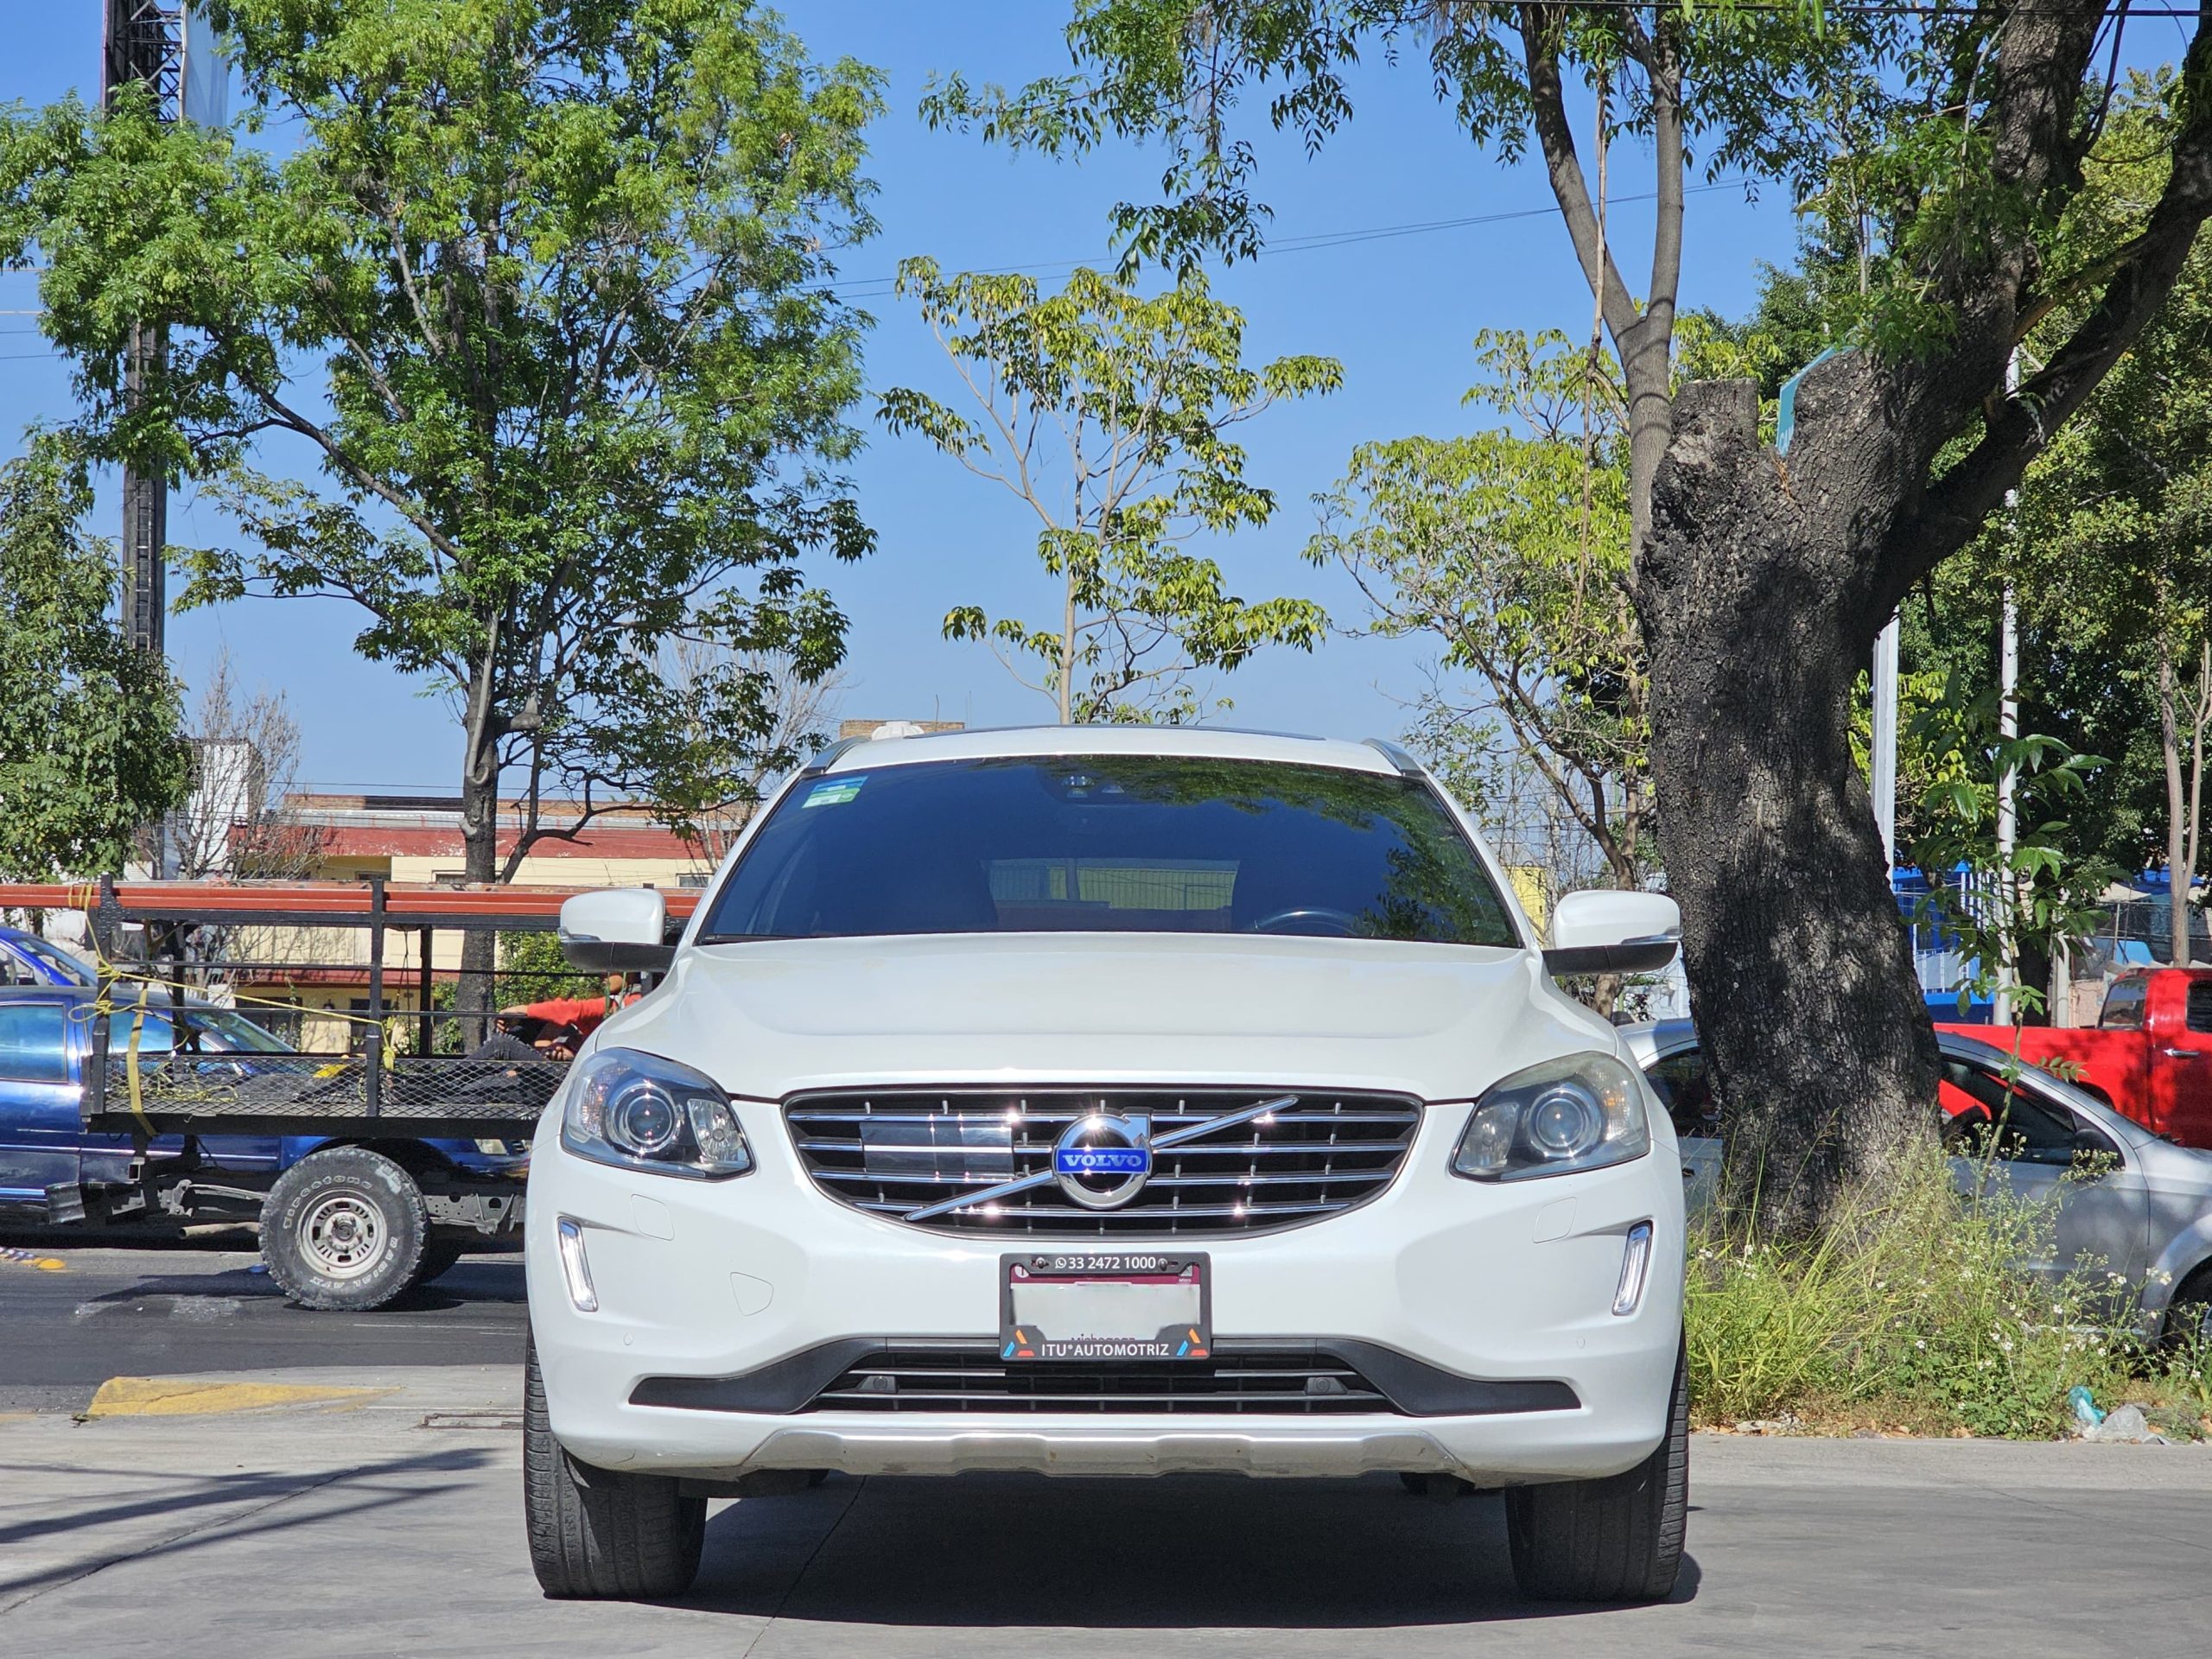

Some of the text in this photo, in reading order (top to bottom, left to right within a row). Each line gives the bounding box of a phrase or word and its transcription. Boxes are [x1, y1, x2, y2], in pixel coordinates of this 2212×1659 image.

[1063, 1154, 1142, 1167] VOLVO
[353, 1236, 398, 1287] RADIAL
[1068, 1256, 1156, 1269] 33 2472 1000
[1073, 1343, 1170, 1357] AUTOMOTRIZ
